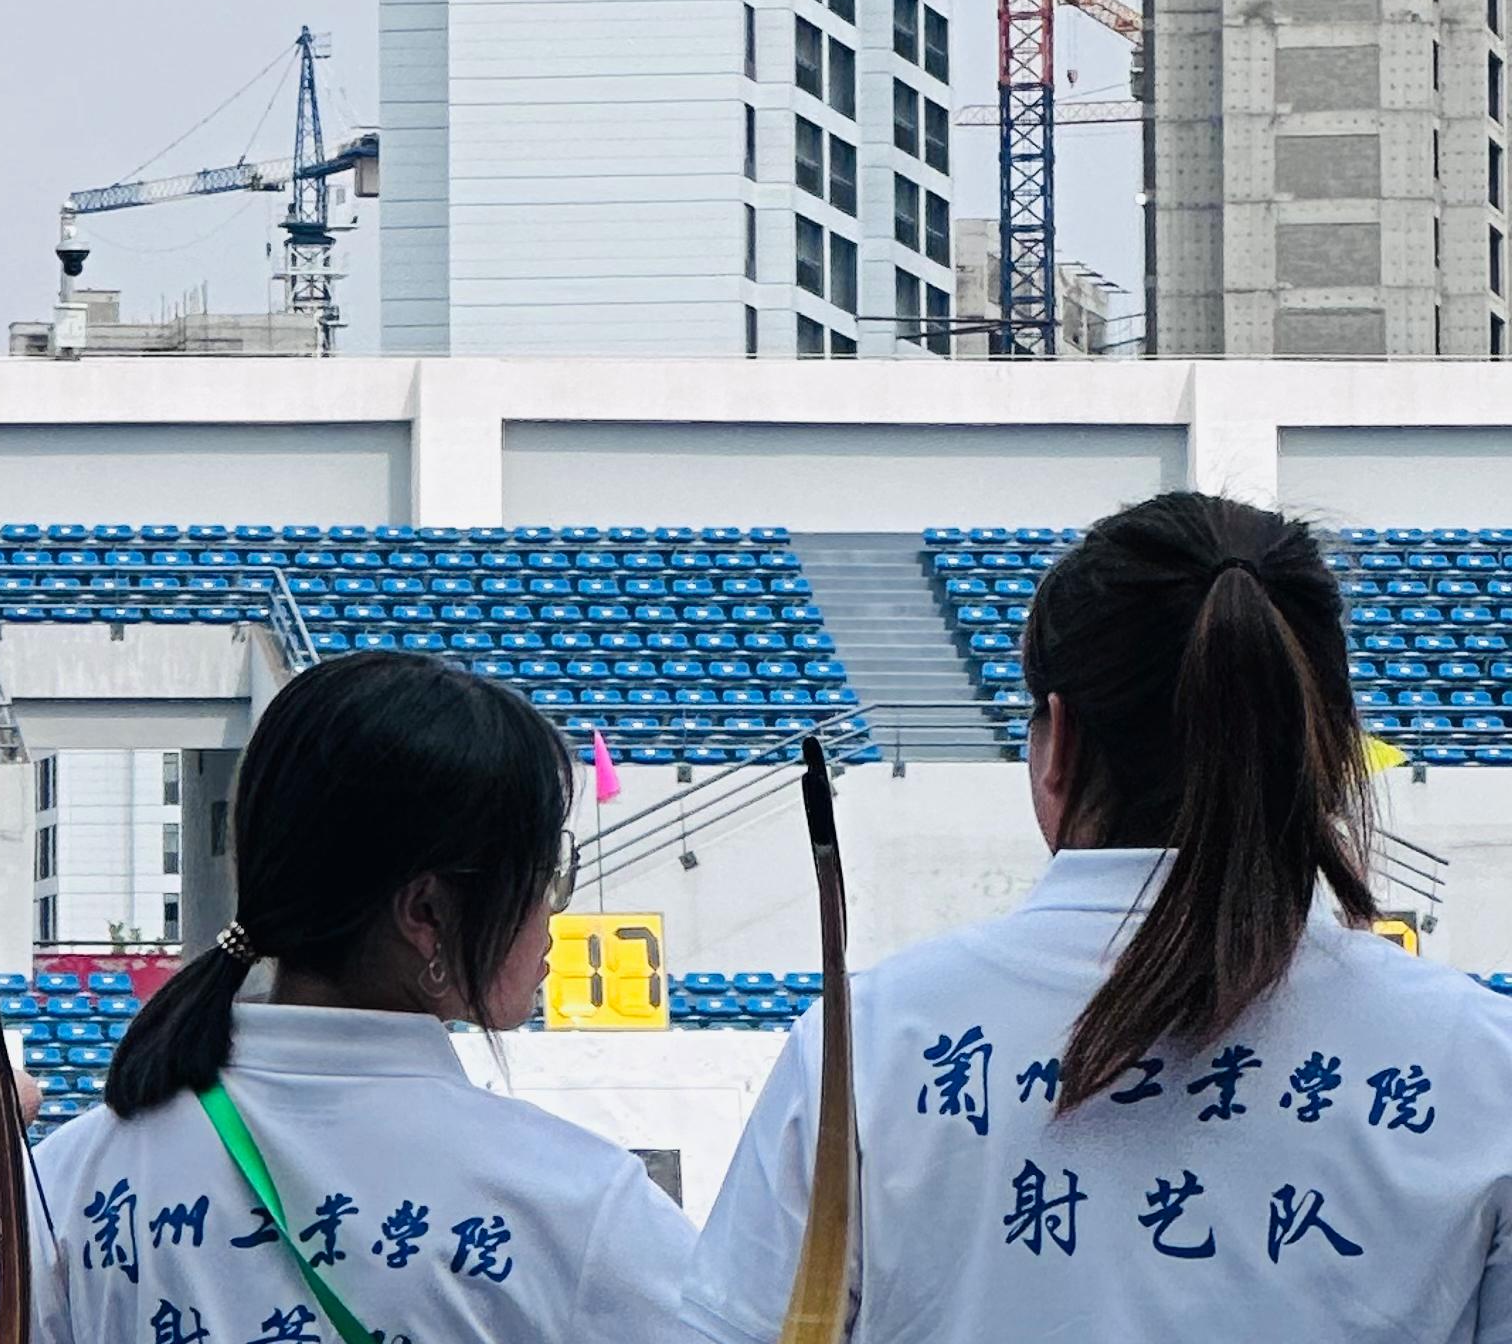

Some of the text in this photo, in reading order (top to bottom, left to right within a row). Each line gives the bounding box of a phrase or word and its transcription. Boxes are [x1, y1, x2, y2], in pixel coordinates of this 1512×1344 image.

[587, 925, 661, 1009] 17
[1002, 1159, 1365, 1265] 射艺队
